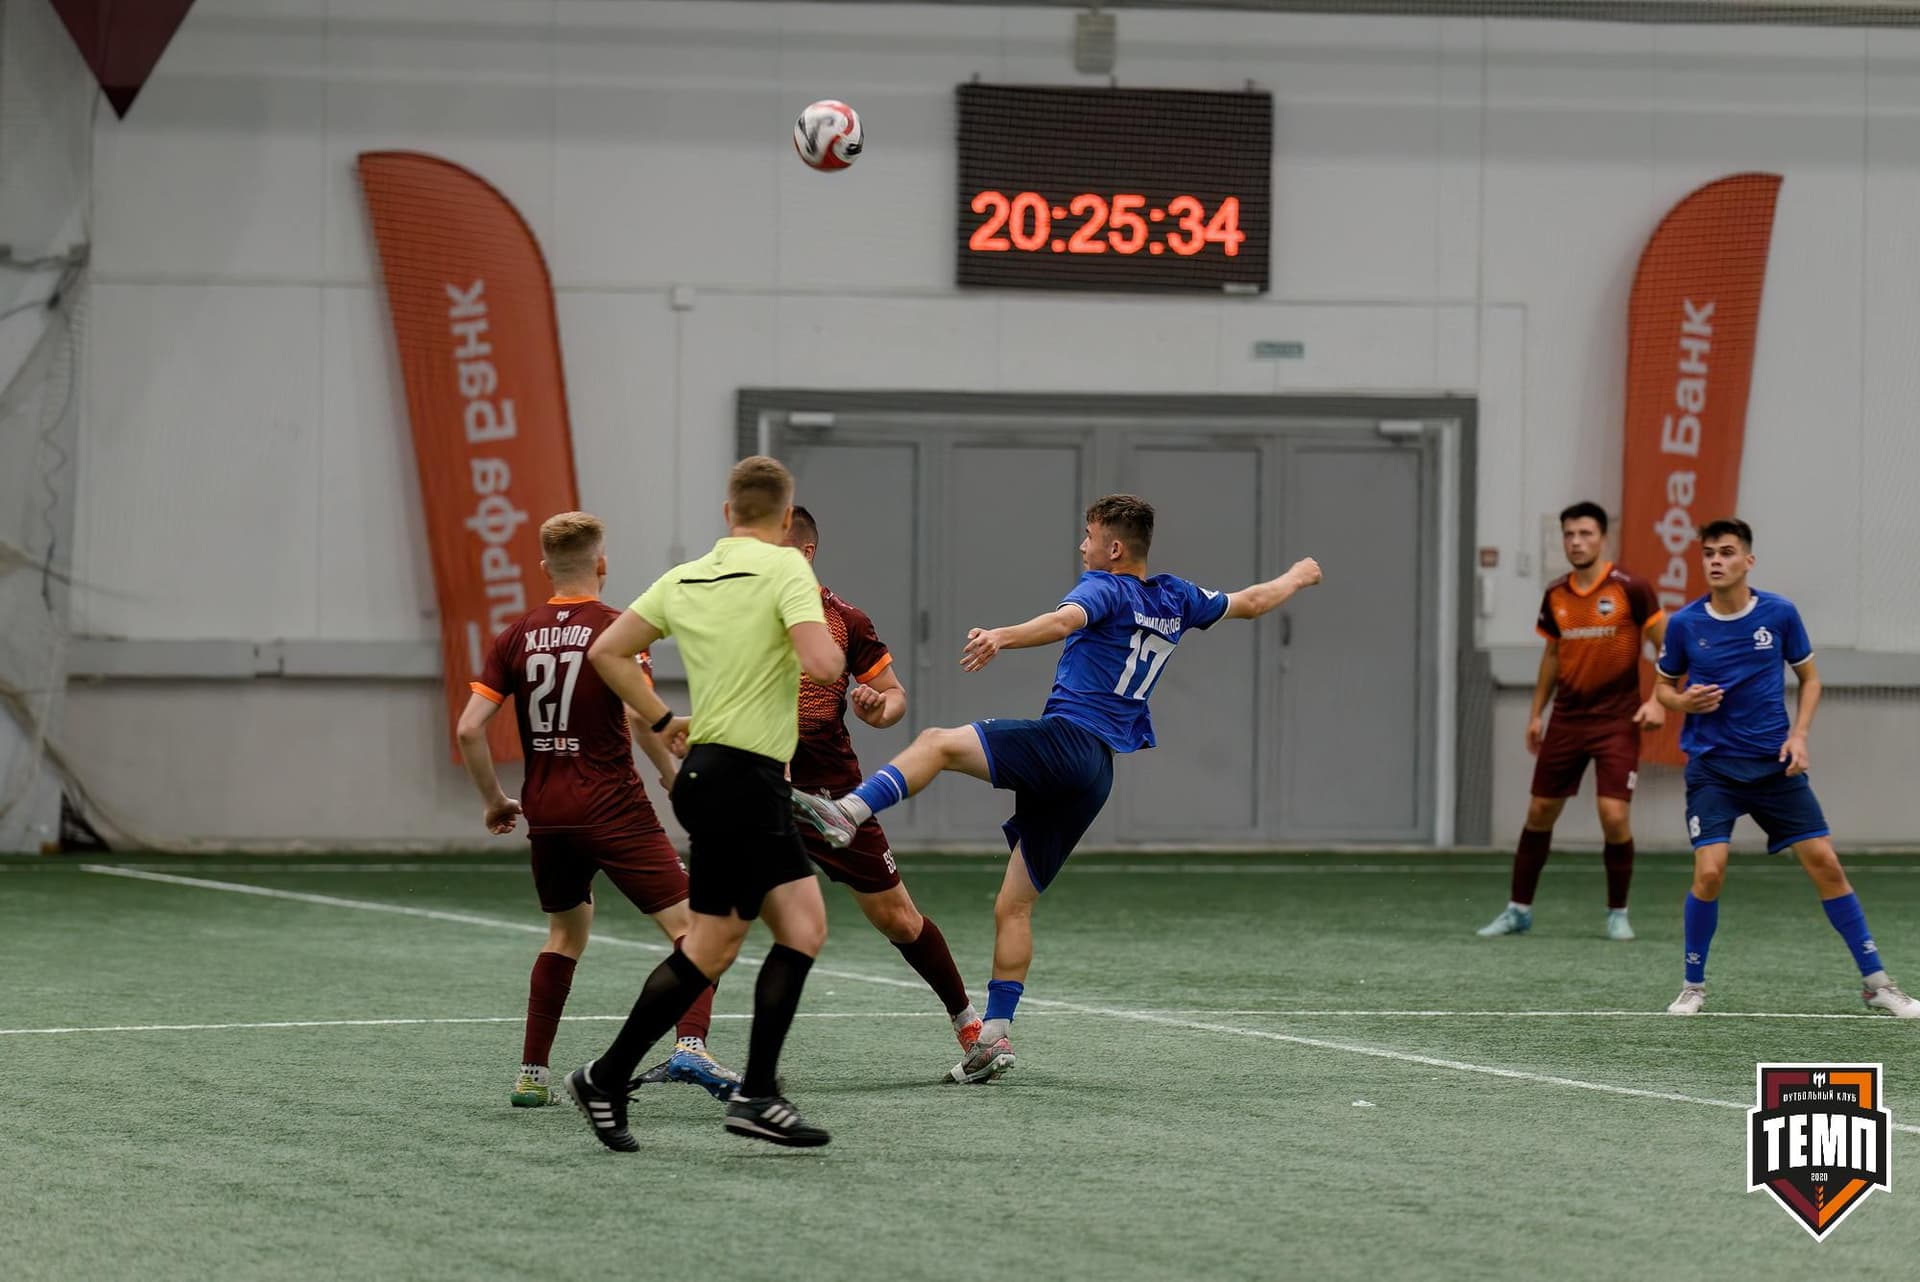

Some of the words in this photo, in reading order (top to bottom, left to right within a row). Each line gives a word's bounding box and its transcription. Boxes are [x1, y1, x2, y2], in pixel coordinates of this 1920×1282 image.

[969, 190, 1246, 257] 20:25:34
[1661, 298, 1716, 458] Банк
[525, 625, 593, 652] ЖДАНОВ
[1114, 629, 1177, 700] 17
[526, 651, 584, 733] 27
